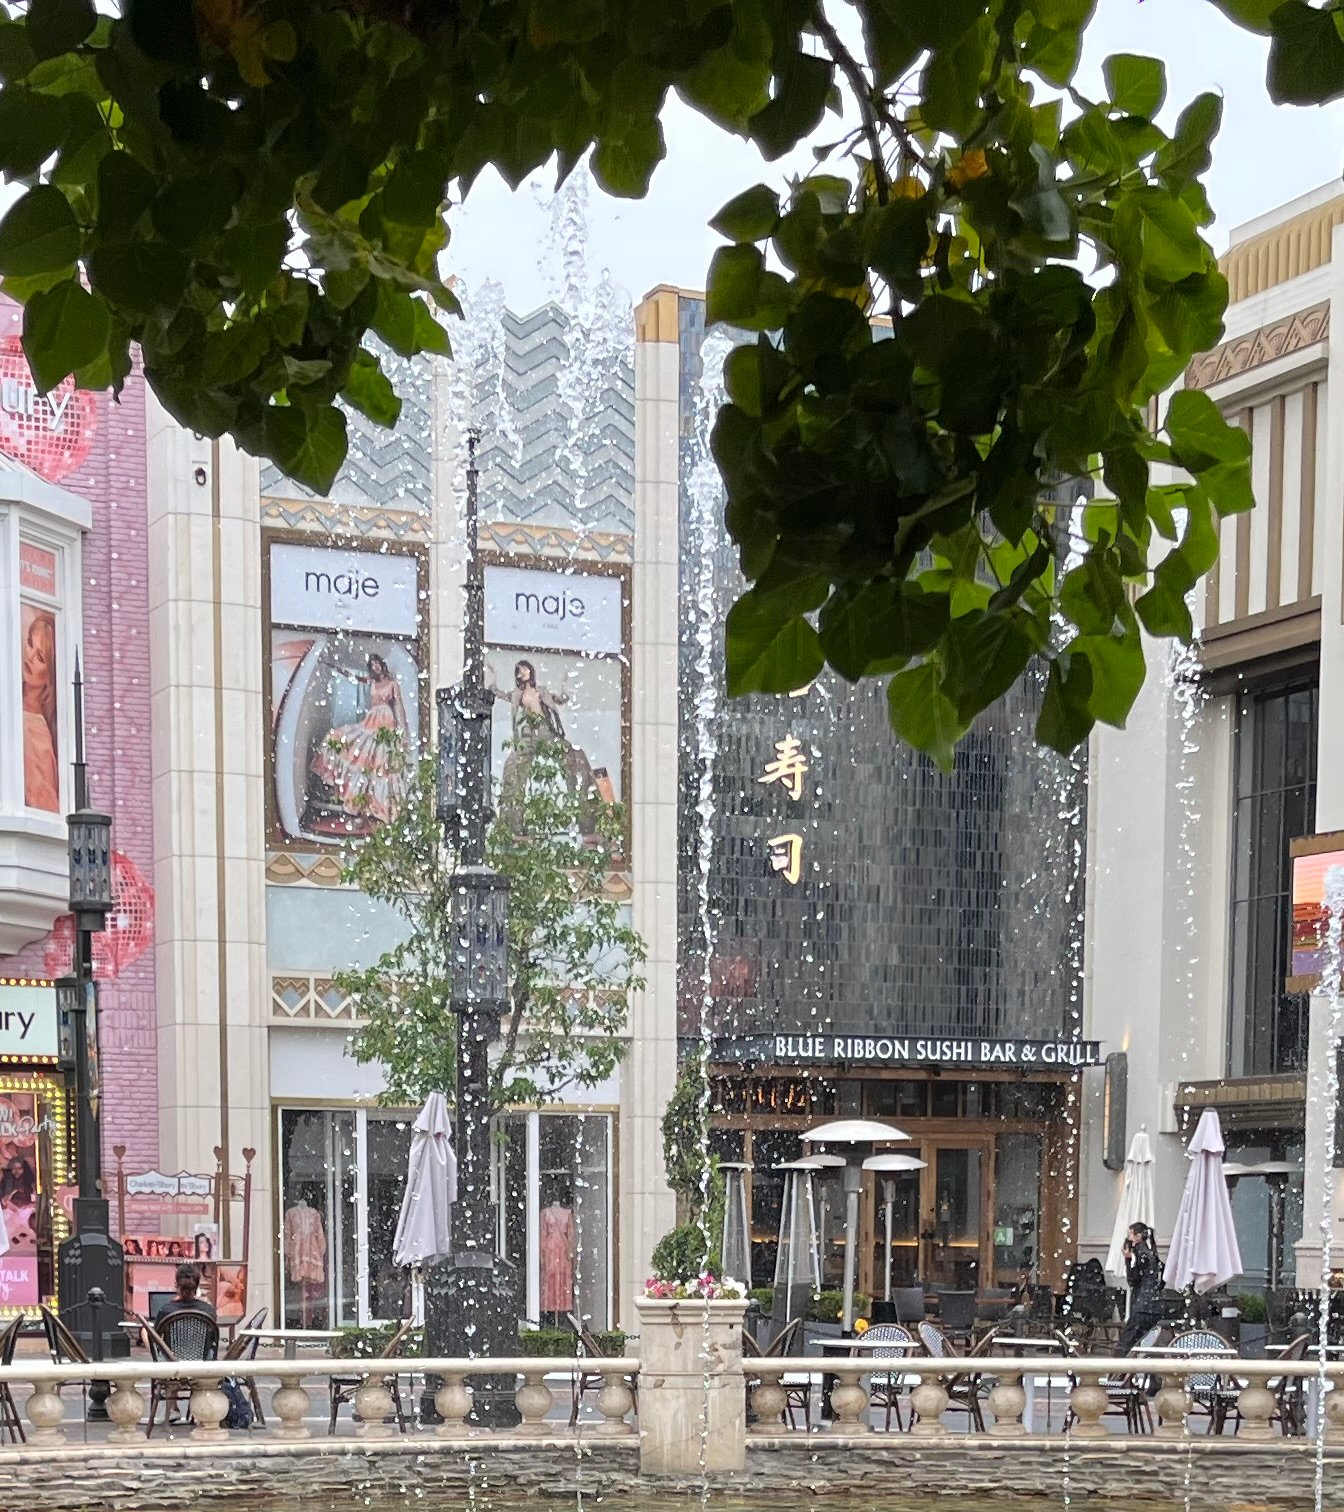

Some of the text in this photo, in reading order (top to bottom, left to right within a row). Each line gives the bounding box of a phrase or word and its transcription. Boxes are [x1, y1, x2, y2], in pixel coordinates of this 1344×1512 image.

[305, 569, 379, 600] maje
[515, 590, 585, 621] maje
[774, 1036, 1096, 1064] BLUE RIBBON SUSHI BAR & GRILL
